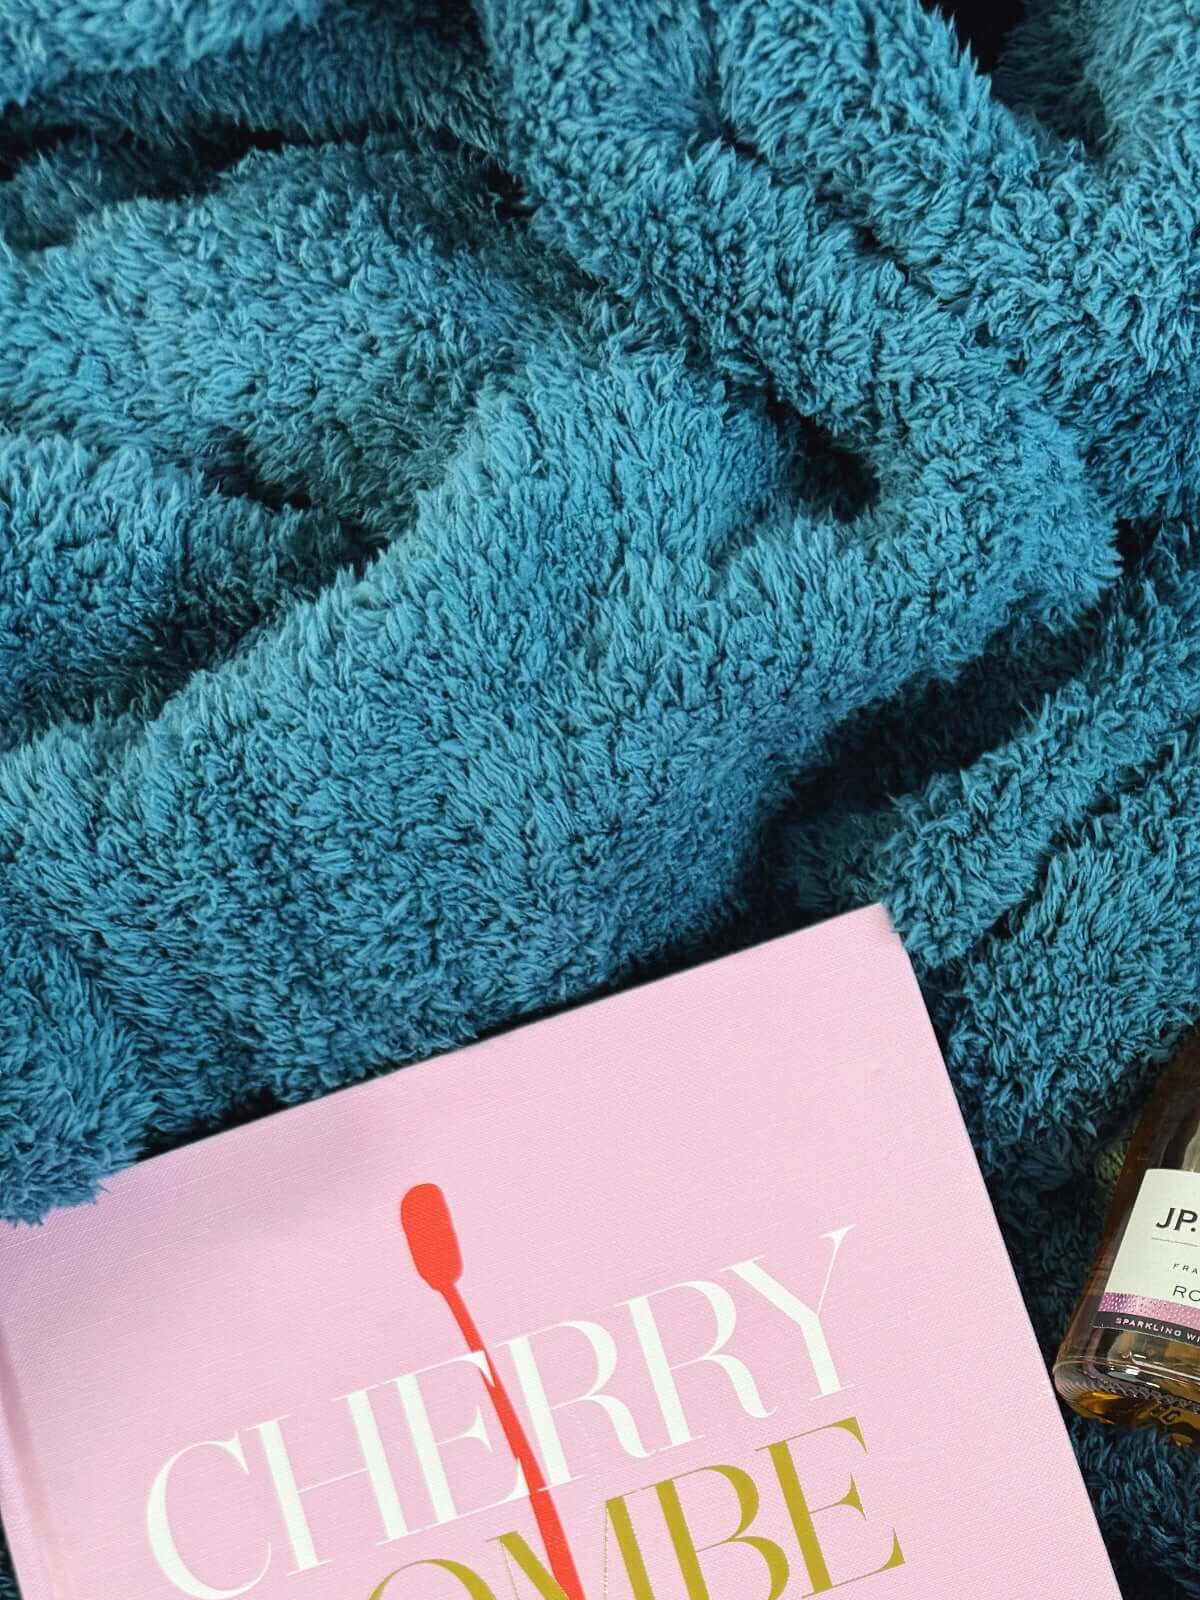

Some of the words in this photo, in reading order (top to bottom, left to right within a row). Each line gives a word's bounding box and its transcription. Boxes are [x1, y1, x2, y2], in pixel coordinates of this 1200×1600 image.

[1155, 1207, 1198, 1233] JP.
[1115, 1316, 1183, 1338] SPARKLING
[146, 1224, 858, 1600] CHERRY
